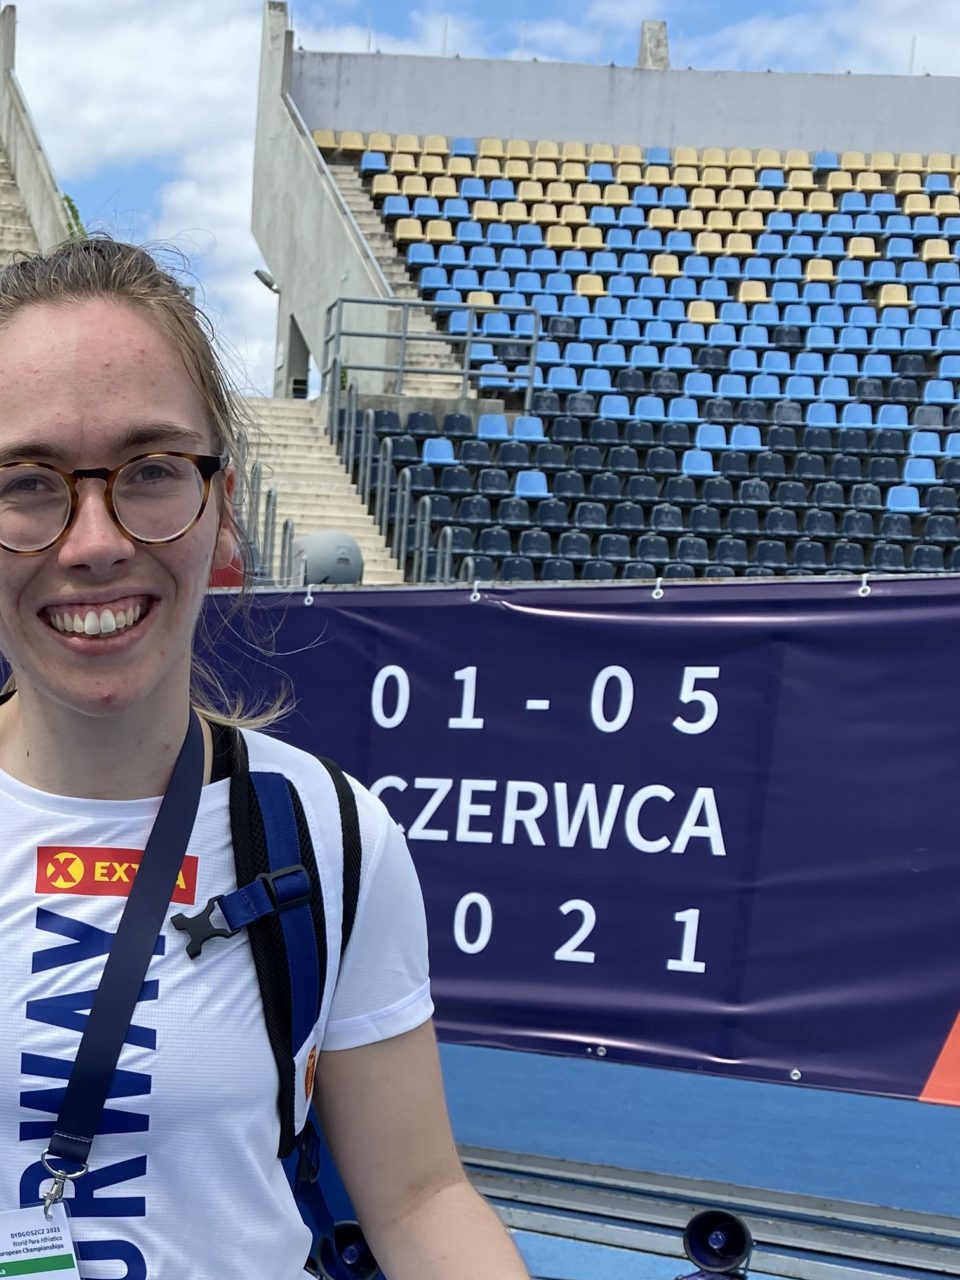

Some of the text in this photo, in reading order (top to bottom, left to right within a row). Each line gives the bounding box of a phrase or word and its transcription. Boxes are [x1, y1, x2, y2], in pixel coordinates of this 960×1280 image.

[94, 861, 186, 890] EXA
[10, 1226, 61, 1239] BYDGOSZCZ 2021
[12, 1238, 28, 1247] World
[40, 1235, 63, 1243] Athletics
[22, 1243, 65, 1254] Championships
